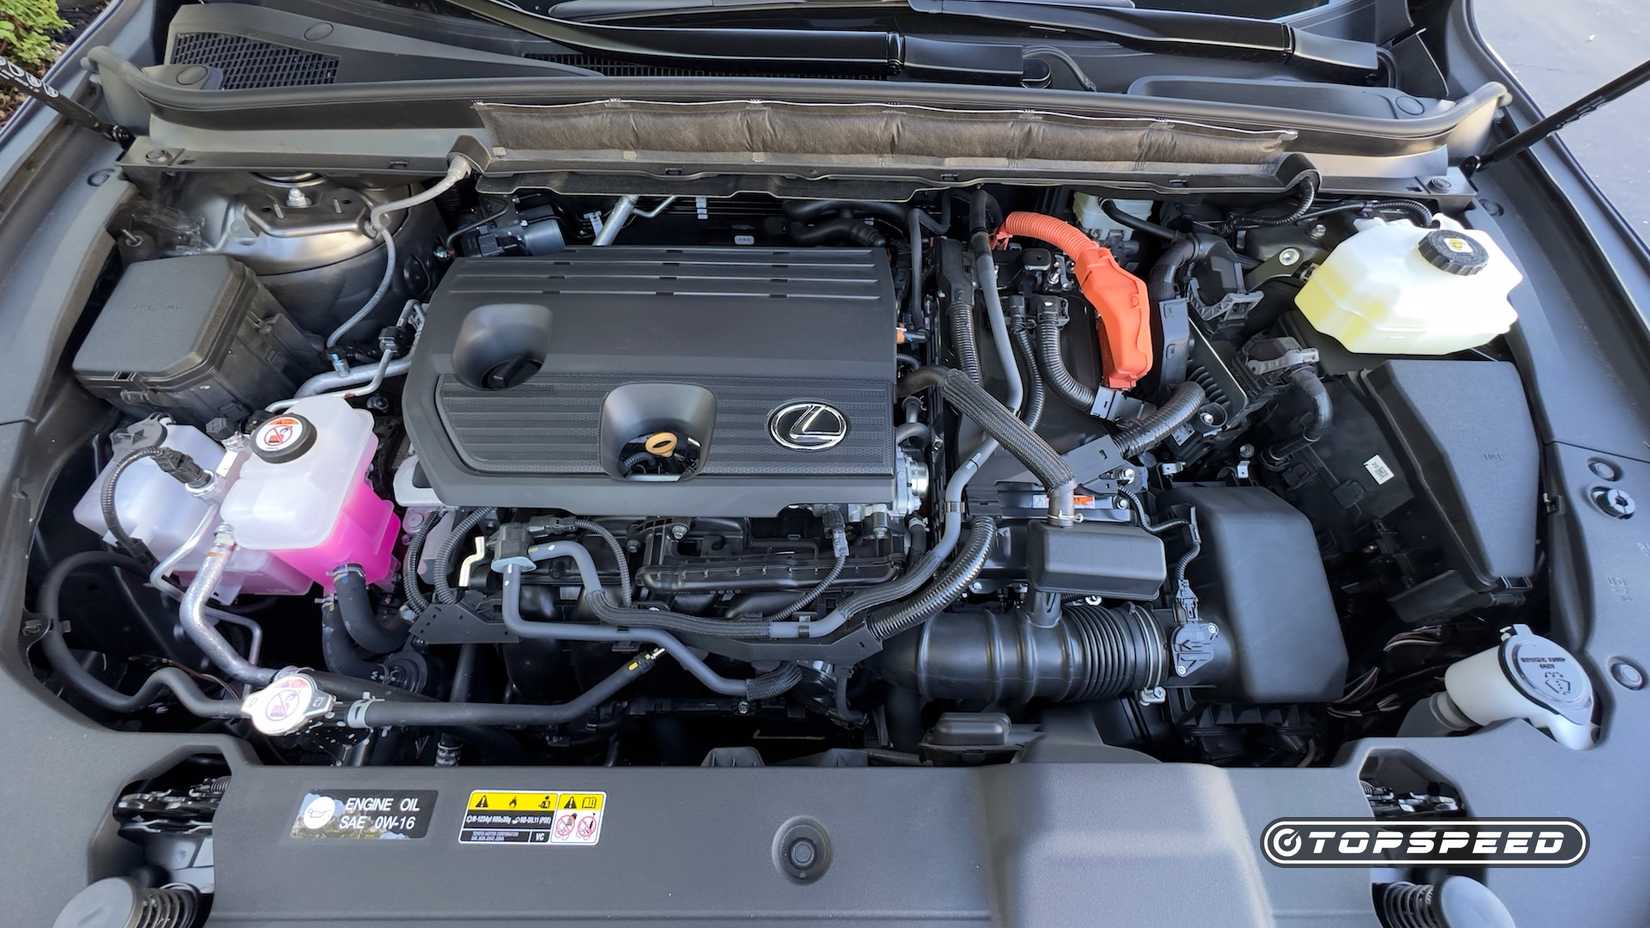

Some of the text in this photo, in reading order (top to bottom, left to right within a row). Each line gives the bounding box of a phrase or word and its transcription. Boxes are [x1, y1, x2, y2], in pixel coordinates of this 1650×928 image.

[345, 798, 420, 811] ENGINE OIL
[340, 816, 416, 829] SAE 0W-16
